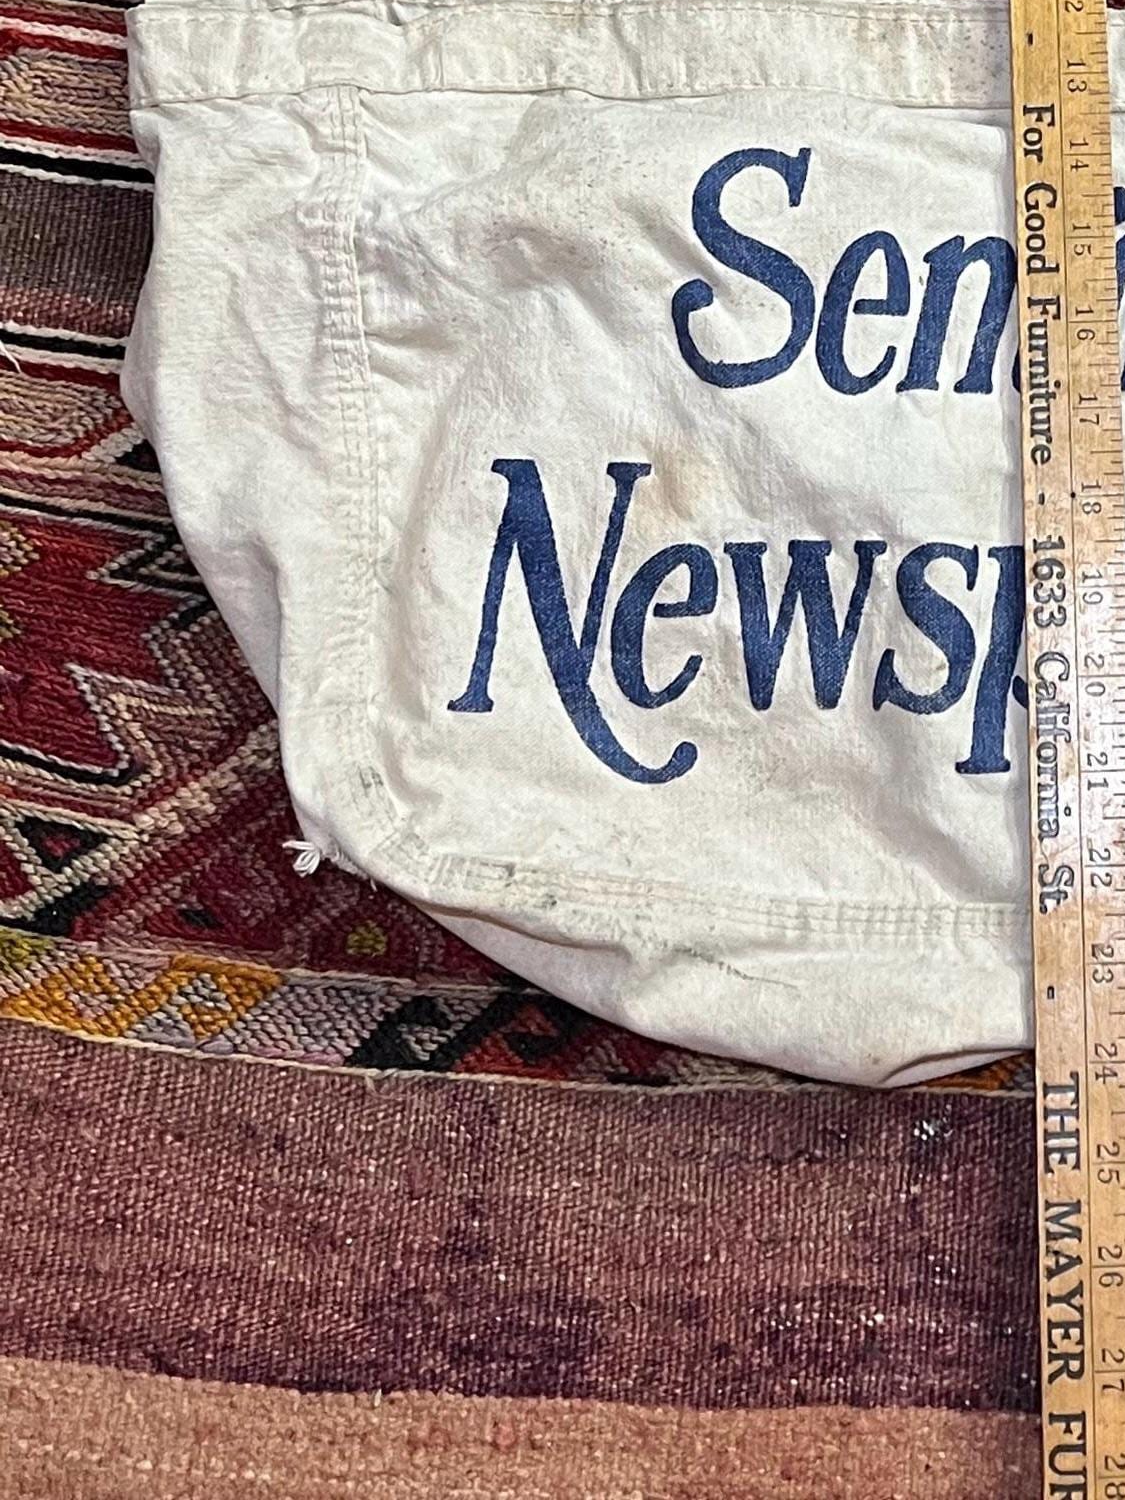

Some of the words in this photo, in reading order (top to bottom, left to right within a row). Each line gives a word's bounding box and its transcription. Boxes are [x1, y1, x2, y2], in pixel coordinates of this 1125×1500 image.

[1066, 58, 1088, 93] 13
[1023, 103, 1055, 163] For
[1069, 138, 1089, 173] 14
[1023, 181, 1060, 276] Good
[1072, 222, 1092, 257] 15
[1075, 307, 1096, 342] 16
[1026, 295, 1063, 466] Furniture
[1078, 393, 1100, 427] 17
[1081, 482, 1102, 516] 18
[1032, 535, 1067, 629] 1633
[1082, 572, 1104, 606] 19
[1084, 655, 1106, 698] 20
[1034, 651, 1072, 841] California
[1086, 751, 1109, 791] 21
[1038, 864, 1075, 915] St.
[1088, 847, 1111, 889] 22
[1091, 942, 1114, 985] 23
[1094, 1042, 1118, 1085] 24
[1043, 1071, 1081, 1175] THE
[1096, 1141, 1121, 1185] 25
[1098, 1244, 1124, 1288] 26
[1044, 1199, 1086, 1385] MAYER
[1102, 1348, 1125, 1393] 27
